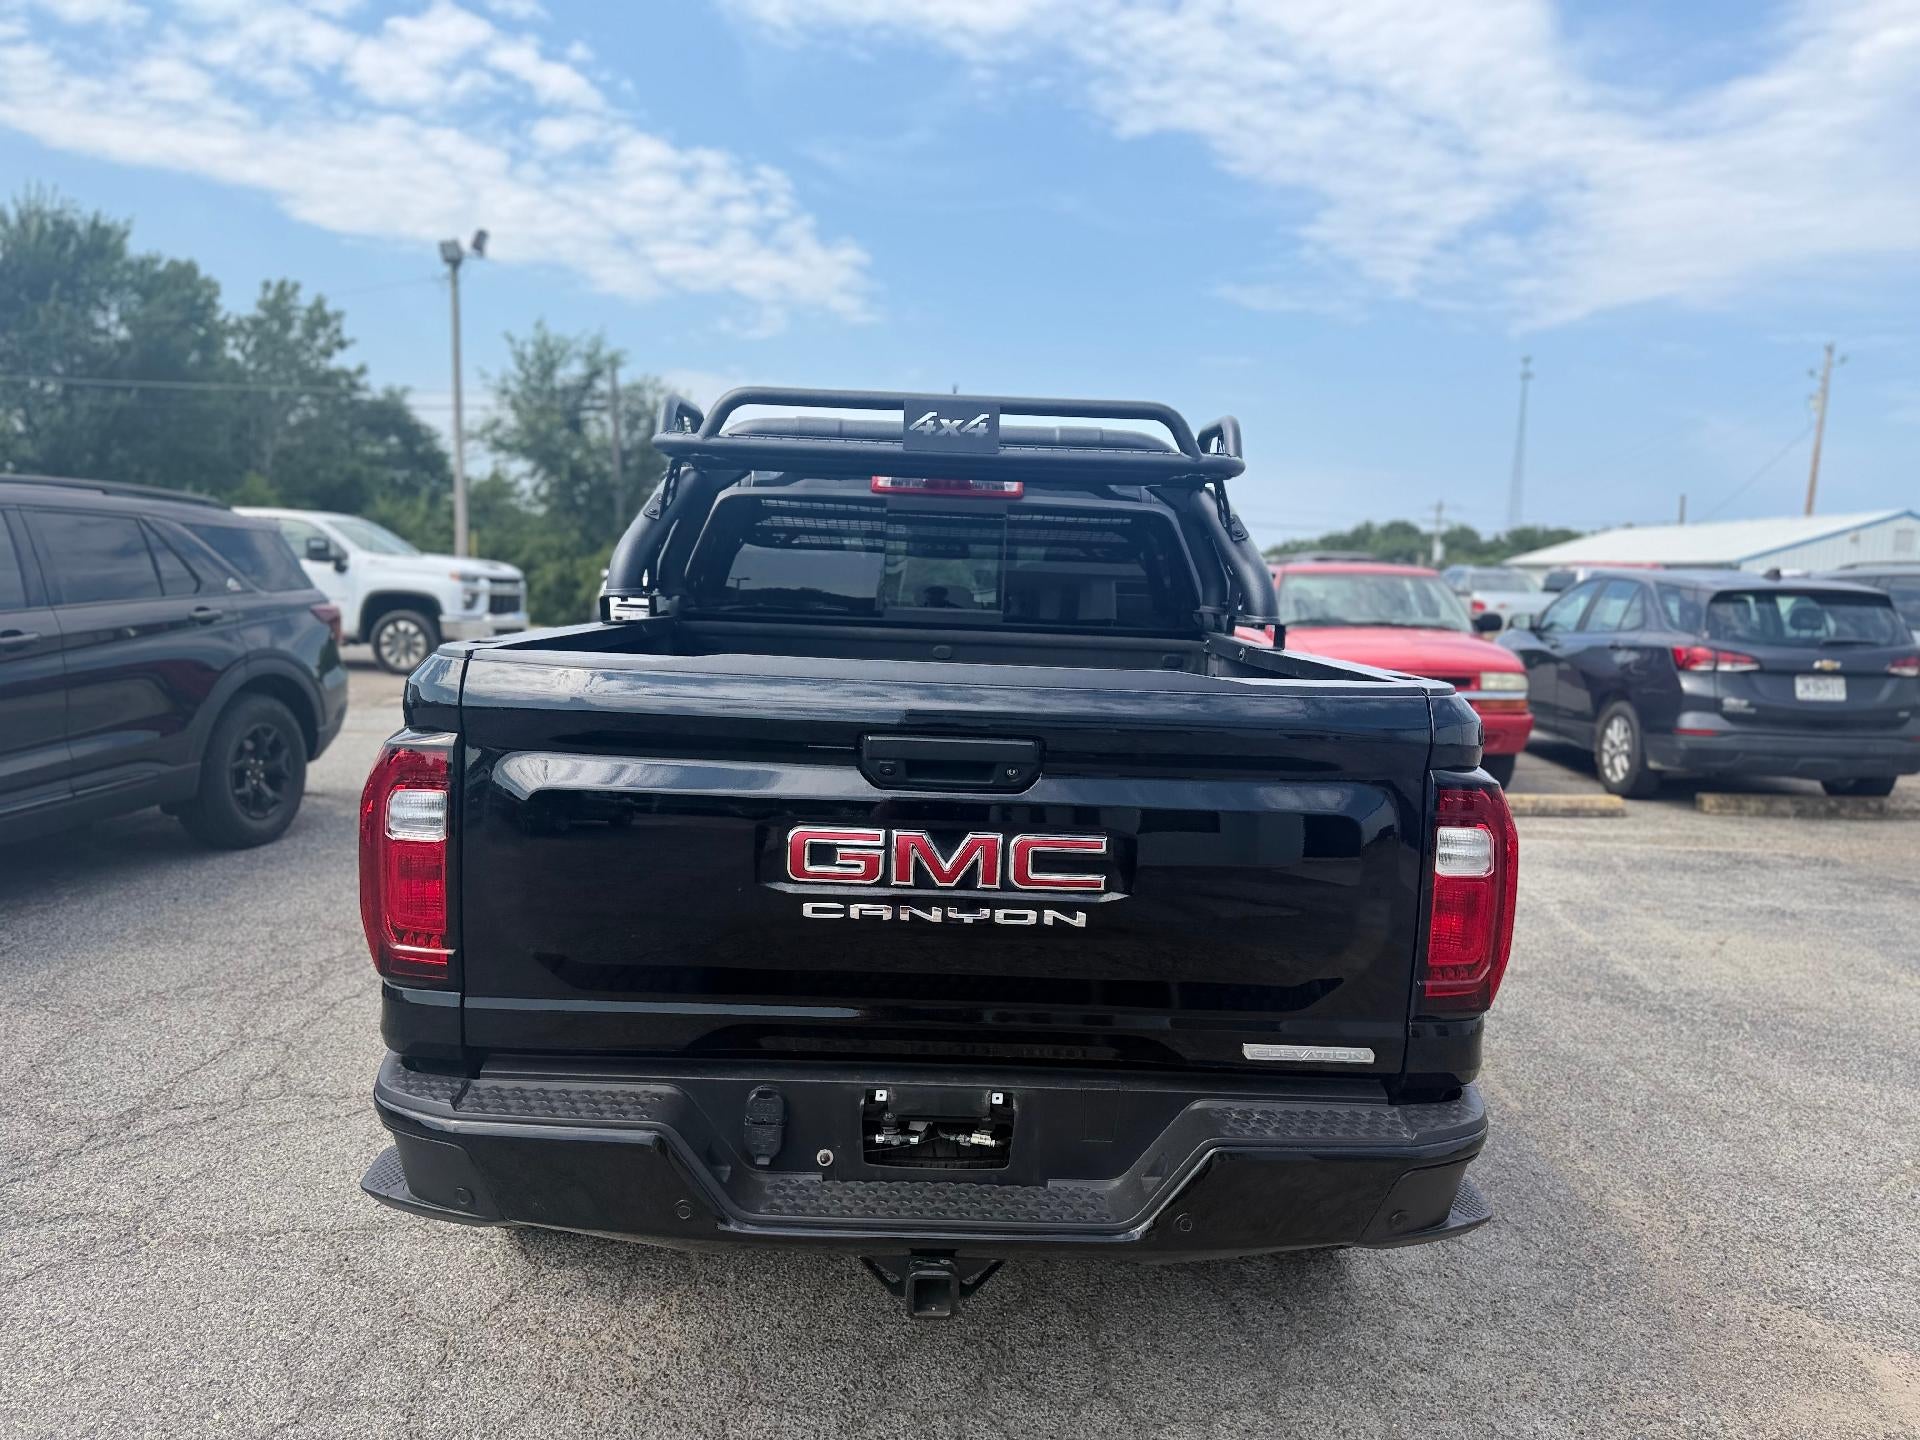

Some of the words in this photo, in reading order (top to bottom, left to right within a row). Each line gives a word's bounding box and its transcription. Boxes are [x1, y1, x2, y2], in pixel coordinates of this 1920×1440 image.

[909, 411, 990, 437] 4x4
[787, 825, 1108, 891] GMC
[802, 902, 1088, 928] CANYON
[1251, 1048, 1366, 1062] ELEVATION
